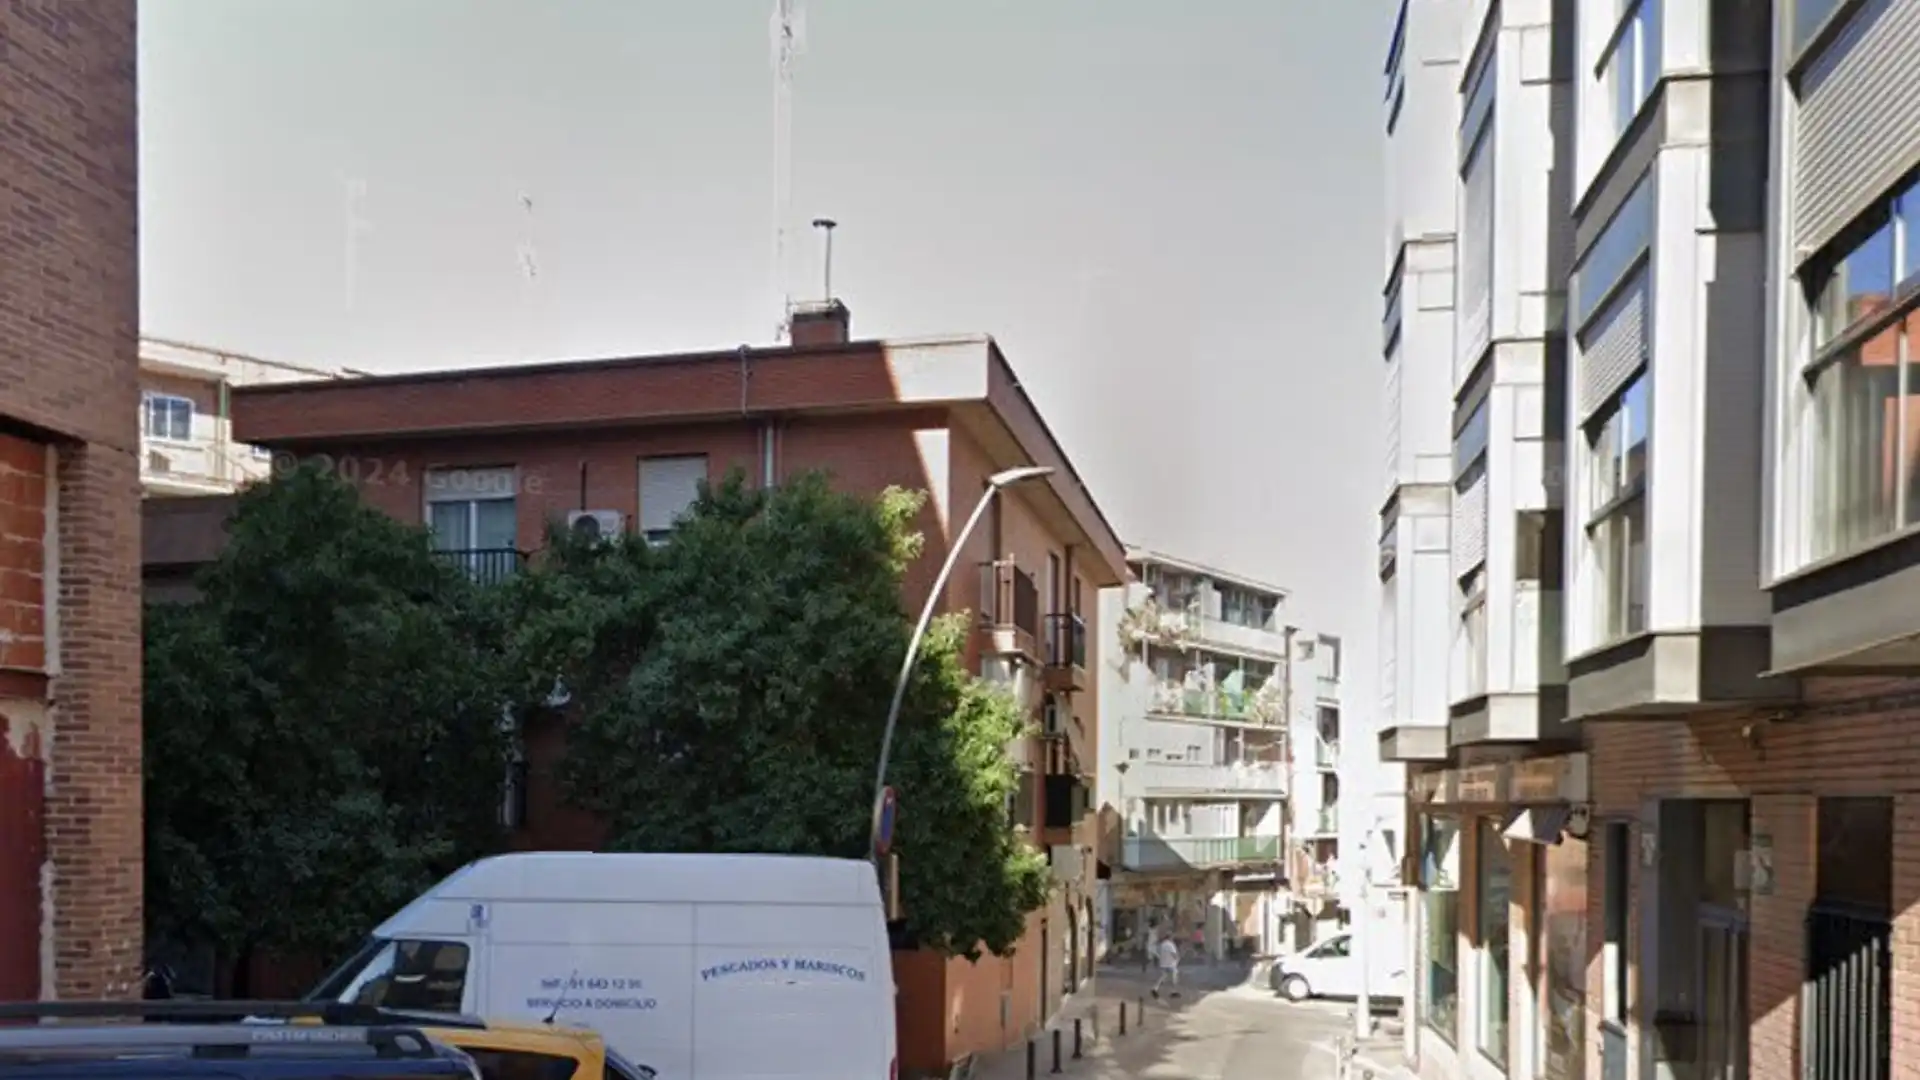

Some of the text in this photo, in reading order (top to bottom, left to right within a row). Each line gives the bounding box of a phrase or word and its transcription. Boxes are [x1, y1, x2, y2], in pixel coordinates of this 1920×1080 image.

[701, 959, 866, 982] PESCADOS Y MARISCOS
